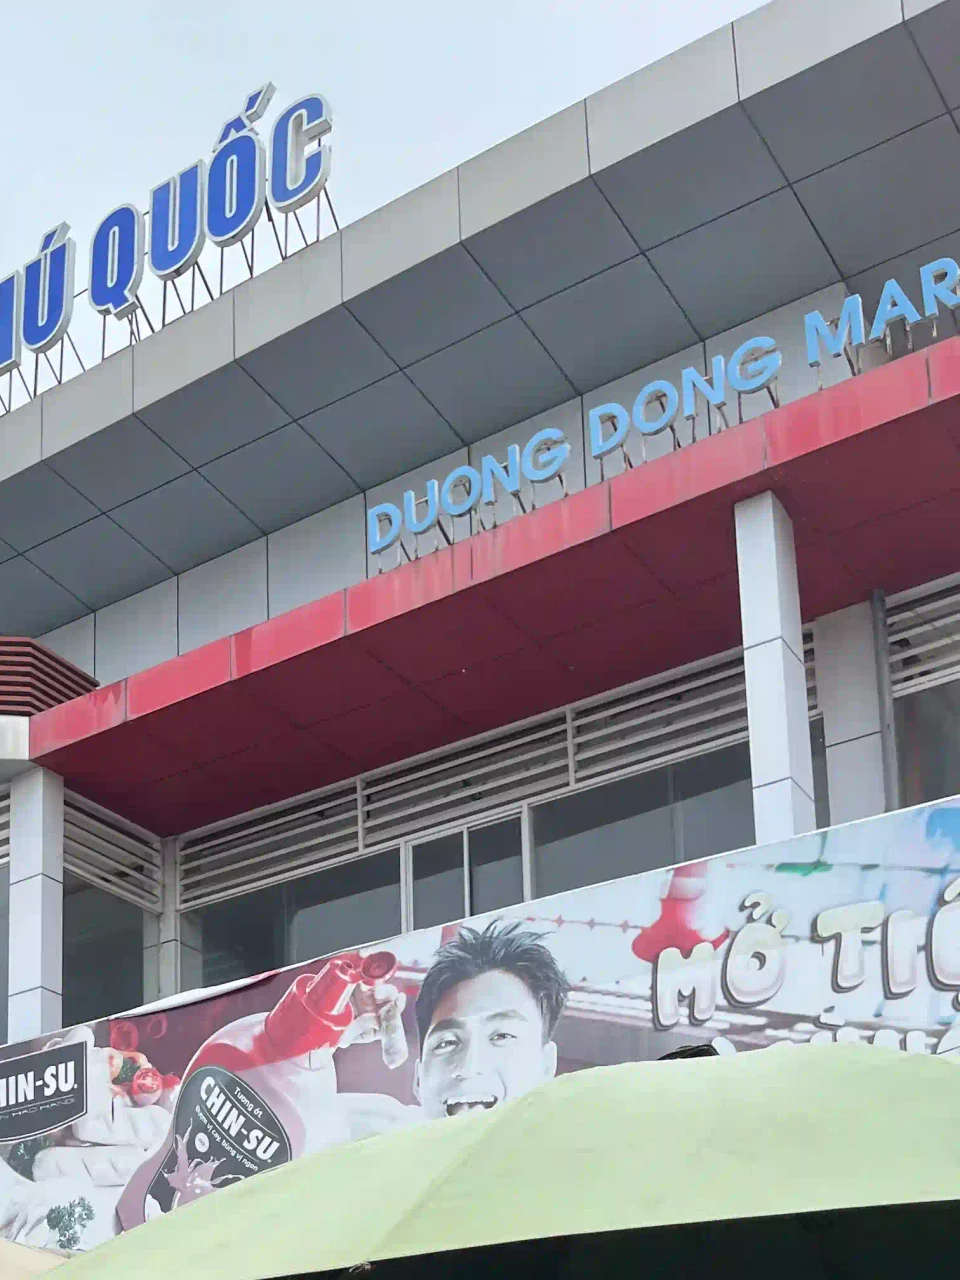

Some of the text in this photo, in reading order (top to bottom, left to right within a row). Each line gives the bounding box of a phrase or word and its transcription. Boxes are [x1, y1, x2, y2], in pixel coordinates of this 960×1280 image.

[88, 81, 332, 321] QUỐC
[367, 427, 571, 555] DUONG
[589, 336, 783, 459] DONG
[652, 892, 791, 1031] MỞ
[200, 1077, 280, 1163] CHIN-SU
